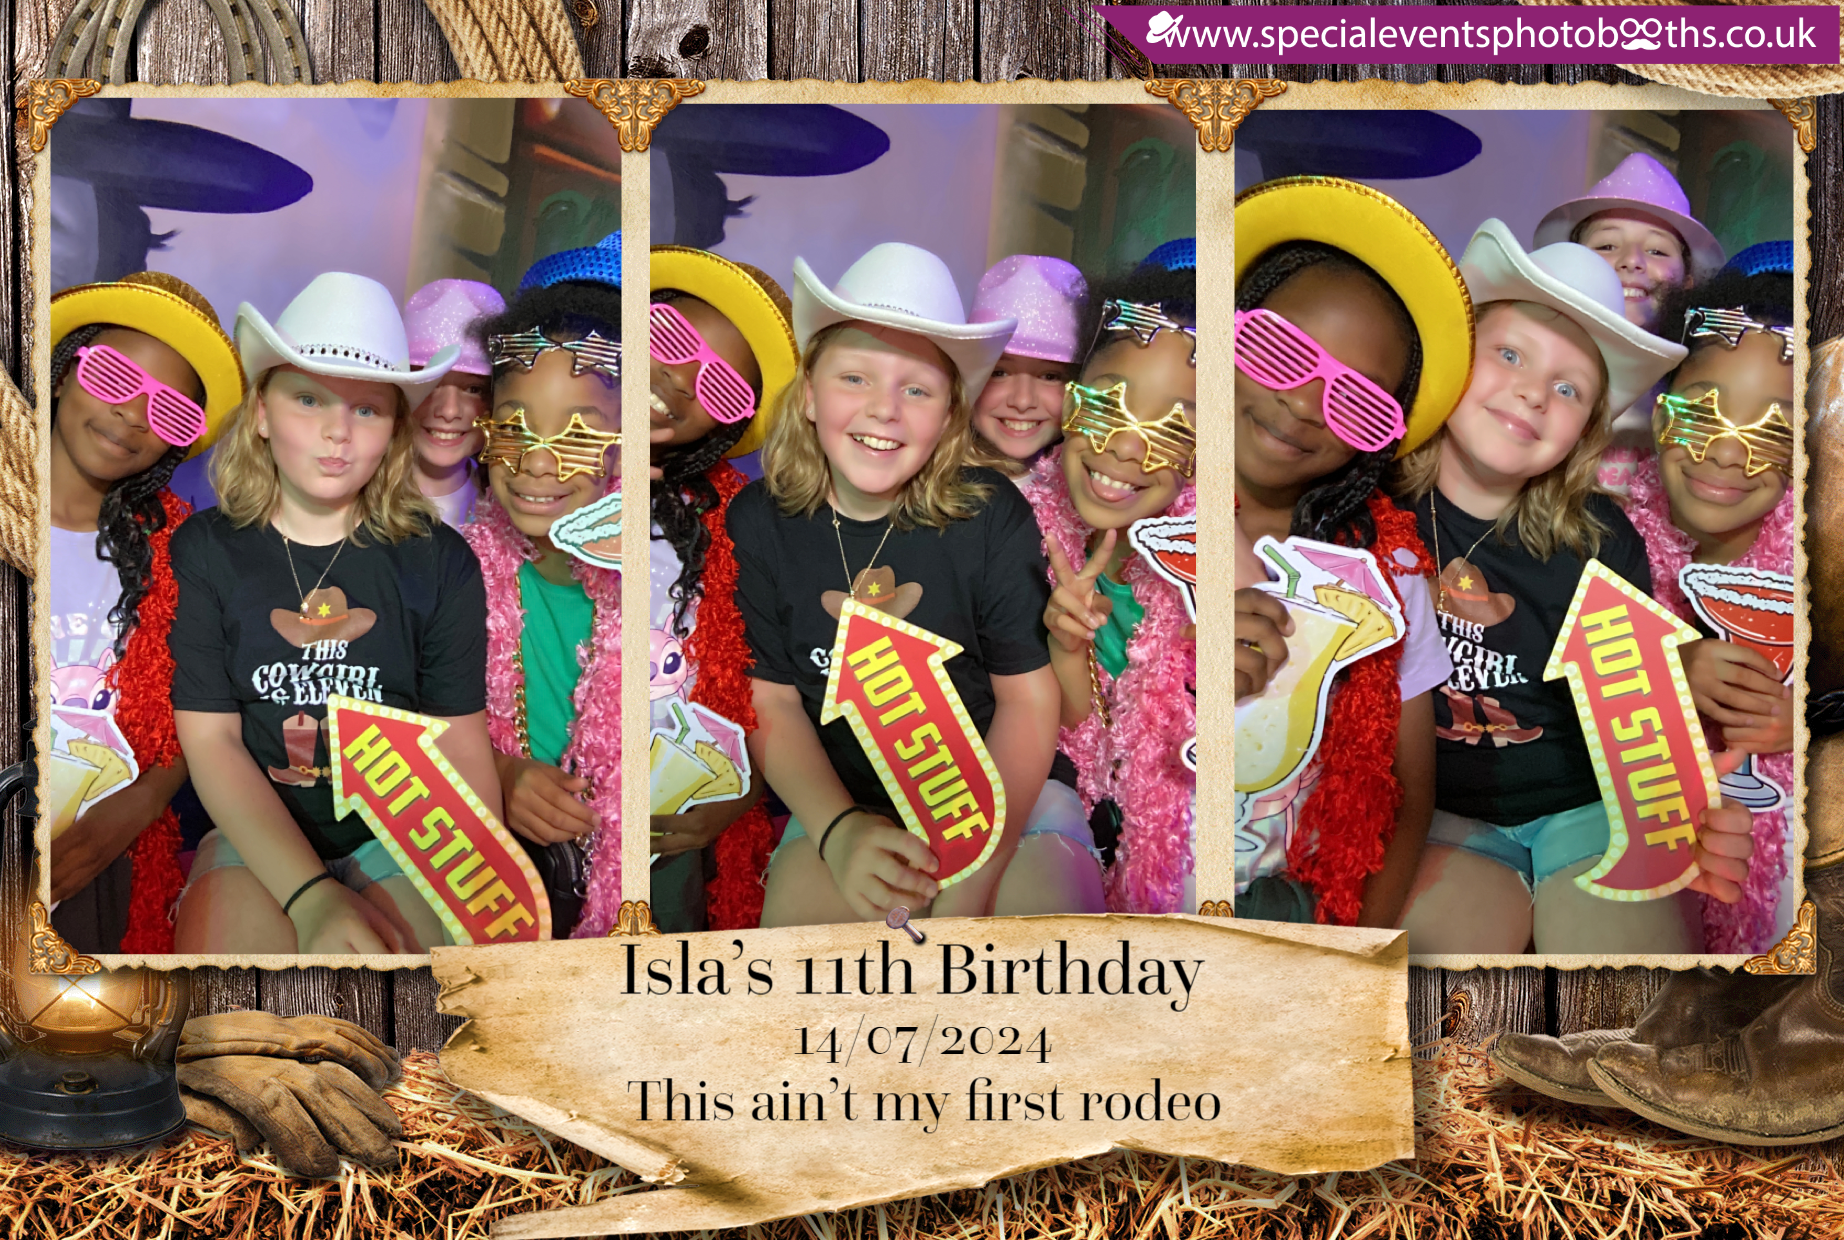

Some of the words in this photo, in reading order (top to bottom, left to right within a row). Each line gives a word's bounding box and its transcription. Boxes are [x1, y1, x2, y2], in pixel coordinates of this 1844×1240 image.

[301, 638, 349, 660] THIS
[1437, 610, 1485, 643] THIS
[1580, 604, 1651, 700] HOT
[846, 635, 927, 728] HOT
[894, 722, 990, 842] STUFF
[1611, 706, 1697, 851] STUFF
[342, 723, 431, 818] HOT
[408, 806, 535, 940] STUFF
